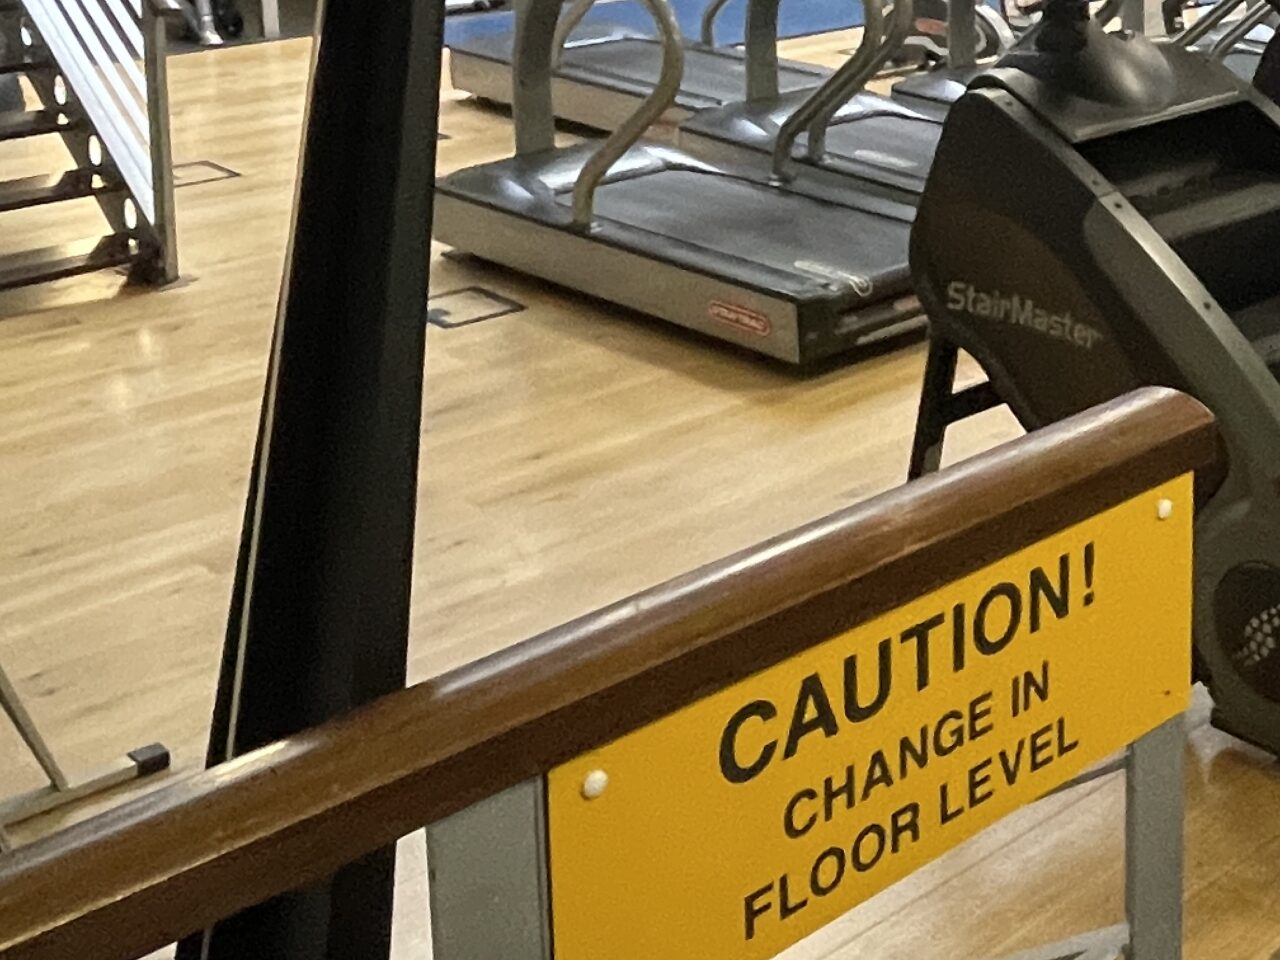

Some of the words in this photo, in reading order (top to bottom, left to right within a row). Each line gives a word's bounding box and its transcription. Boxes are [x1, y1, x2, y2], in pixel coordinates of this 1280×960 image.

[947, 281, 1103, 349] StairMaster
[718, 542, 1095, 785] CAUTION!
[783, 691, 993, 840] CHANGE
[1011, 661, 1049, 718] IN
[744, 802, 920, 941] FLOOR
[939, 717, 1079, 825] LEVEL
